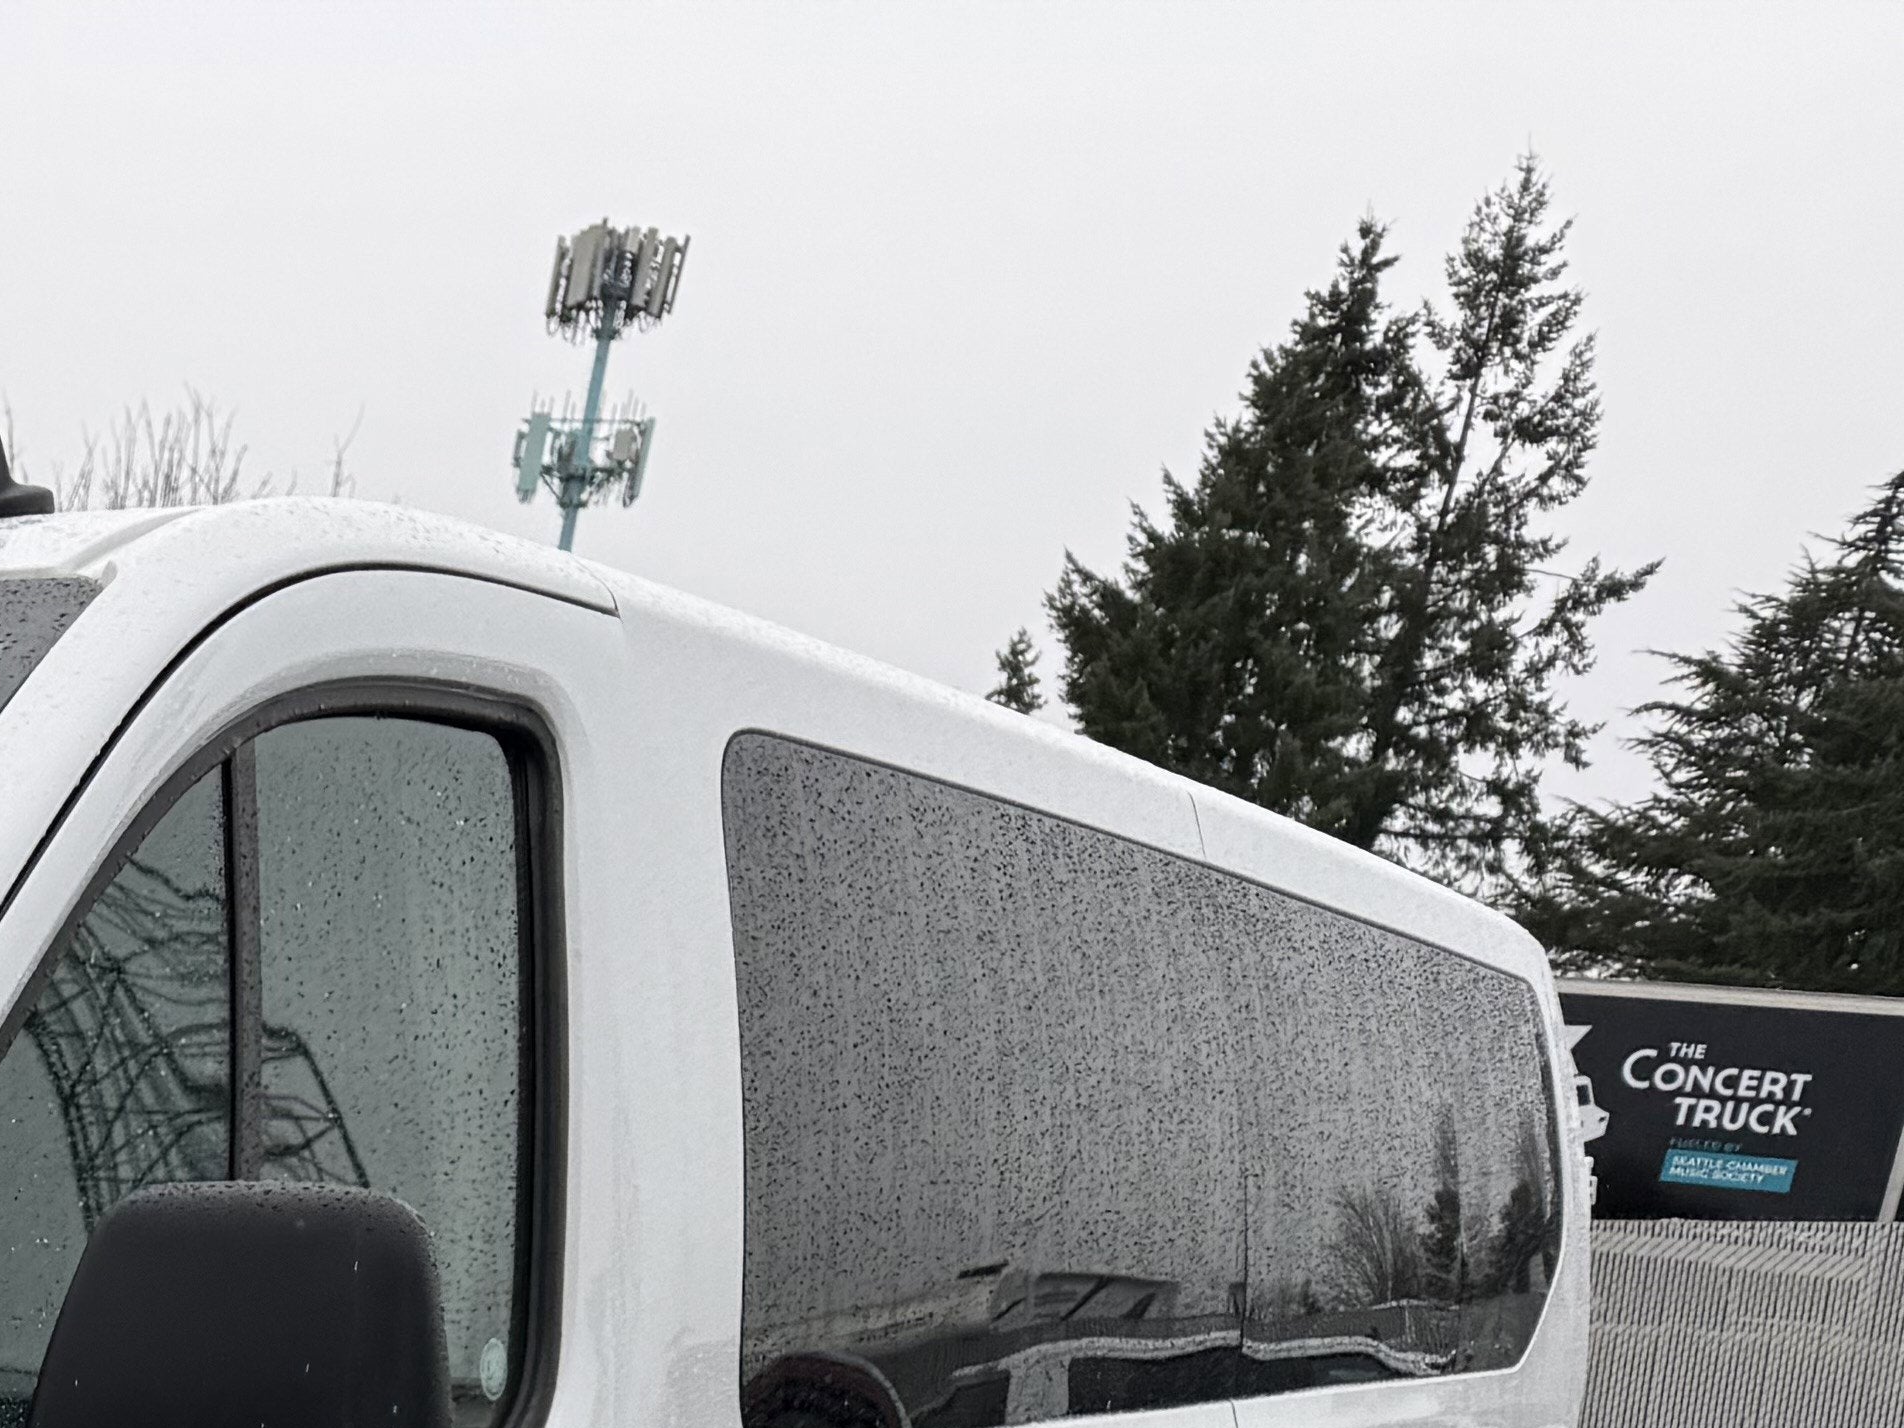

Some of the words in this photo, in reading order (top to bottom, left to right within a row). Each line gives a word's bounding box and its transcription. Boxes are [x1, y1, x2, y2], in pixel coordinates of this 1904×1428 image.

[1669, 1041, 1708, 1060] THE
[1622, 1048, 1814, 1102] CONCERT
[1673, 1096, 1803, 1136] TRUCK
[1668, 1166, 1709, 1180] MUSIC
[1711, 1169, 1766, 1184] SOCIETY
[1672, 1155, 1724, 1169] SEATTLE
[1725, 1160, 1789, 1176] CHAMBER
